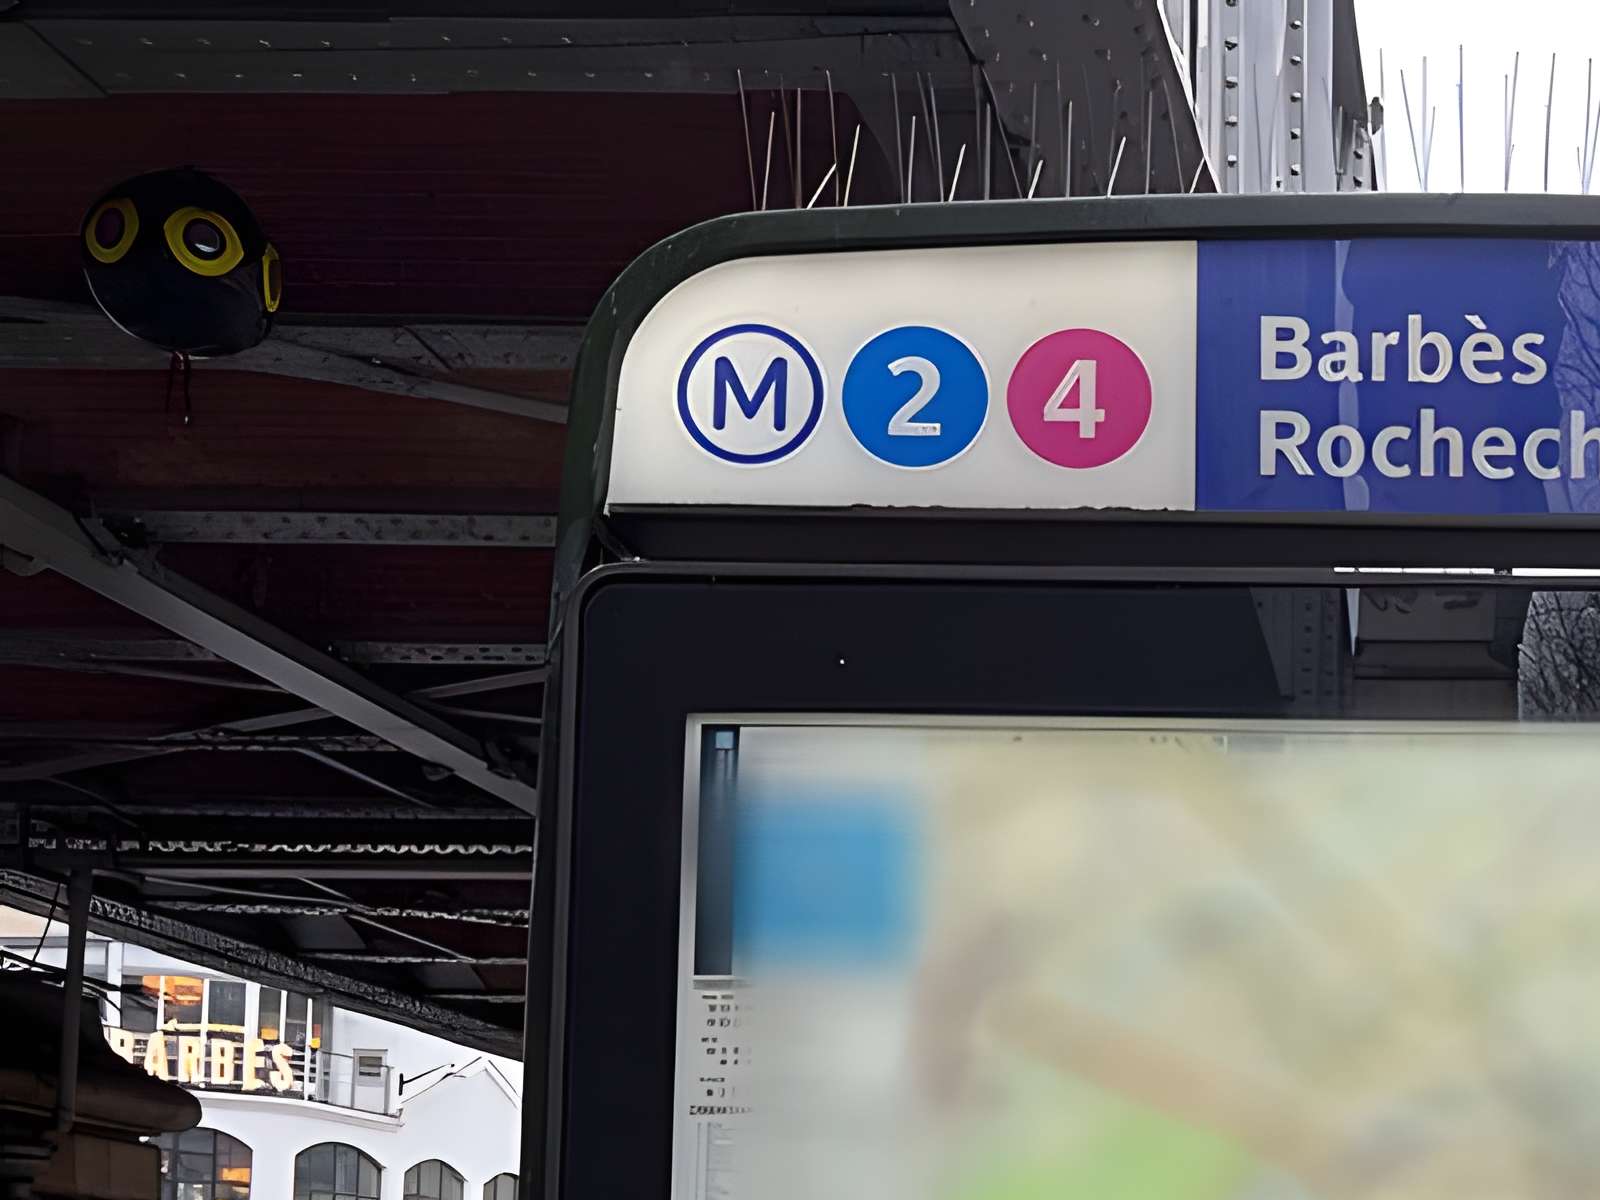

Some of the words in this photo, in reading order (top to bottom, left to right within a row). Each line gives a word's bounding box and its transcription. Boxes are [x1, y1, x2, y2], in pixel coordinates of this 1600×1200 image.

[1260, 314, 1548, 385] Barbès
[712, 356, 788, 432] M
[887, 355, 941, 436] 2
[1043, 359, 1105, 438] 4
